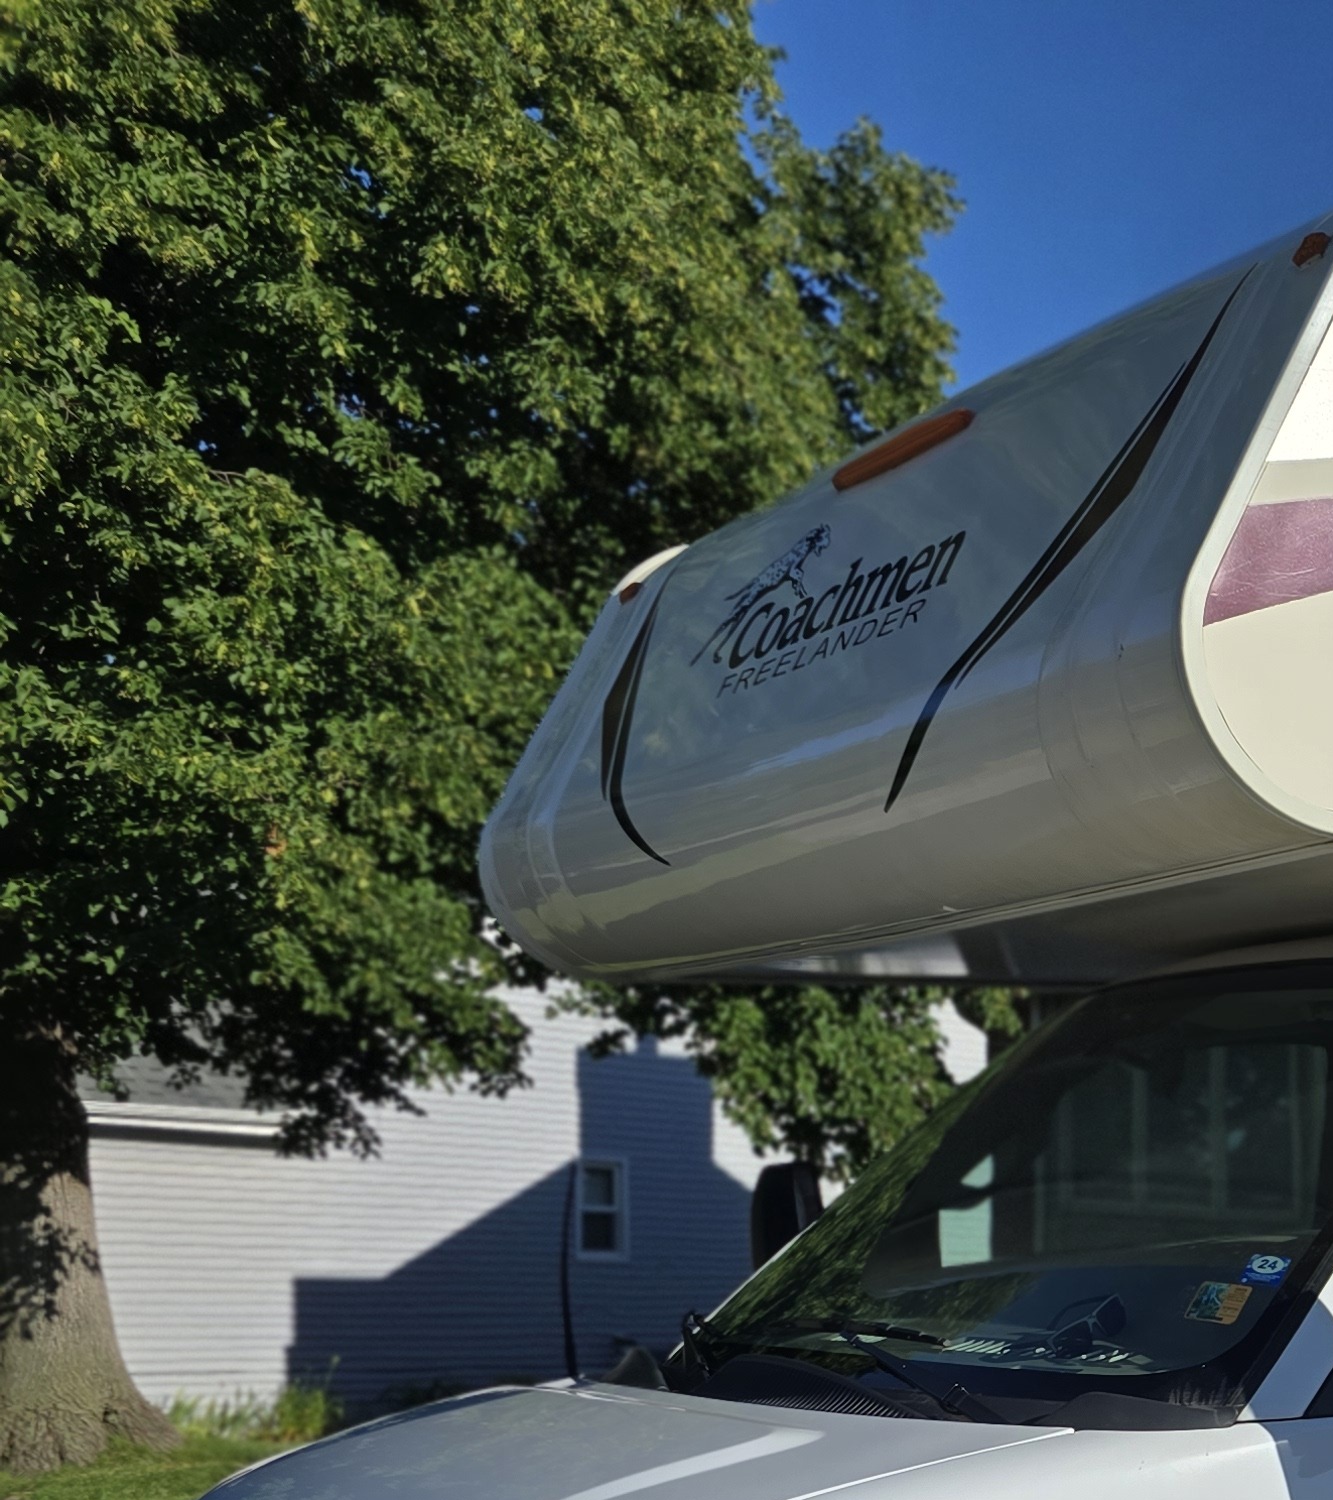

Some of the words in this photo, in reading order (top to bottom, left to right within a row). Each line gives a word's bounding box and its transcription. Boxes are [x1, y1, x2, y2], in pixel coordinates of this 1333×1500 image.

[717, 599, 926, 698] FREELANDER
[729, 530, 966, 669] Coachmen
[1257, 1259, 1278, 1270] 24
